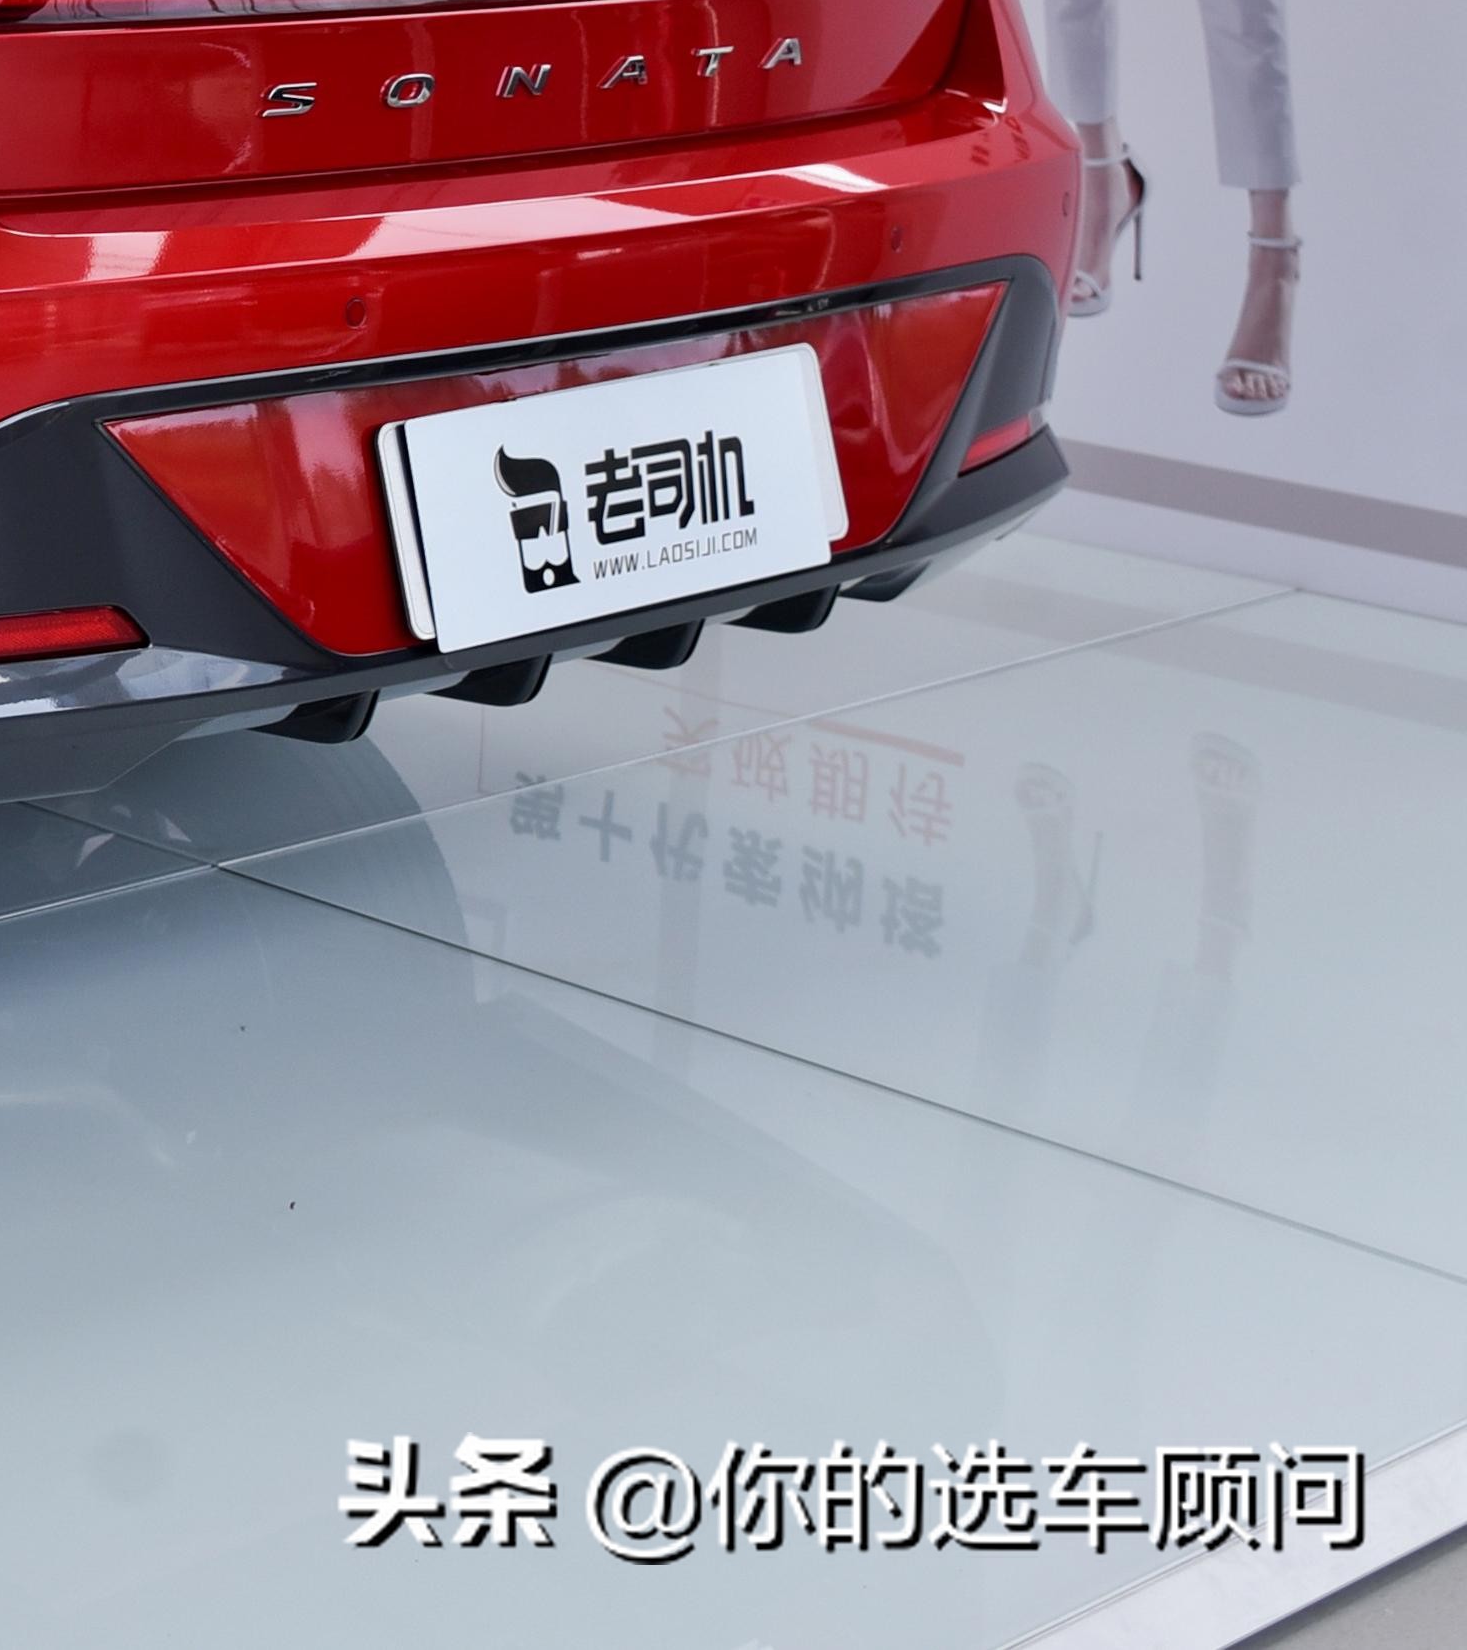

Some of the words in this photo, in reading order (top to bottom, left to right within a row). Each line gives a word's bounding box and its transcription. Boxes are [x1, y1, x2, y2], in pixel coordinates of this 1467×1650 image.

[260, 37, 802, 118] SONATA
[584, 430, 755, 545] 老司机
[593, 527, 758, 580] WWW.LAOSIJI.COM
